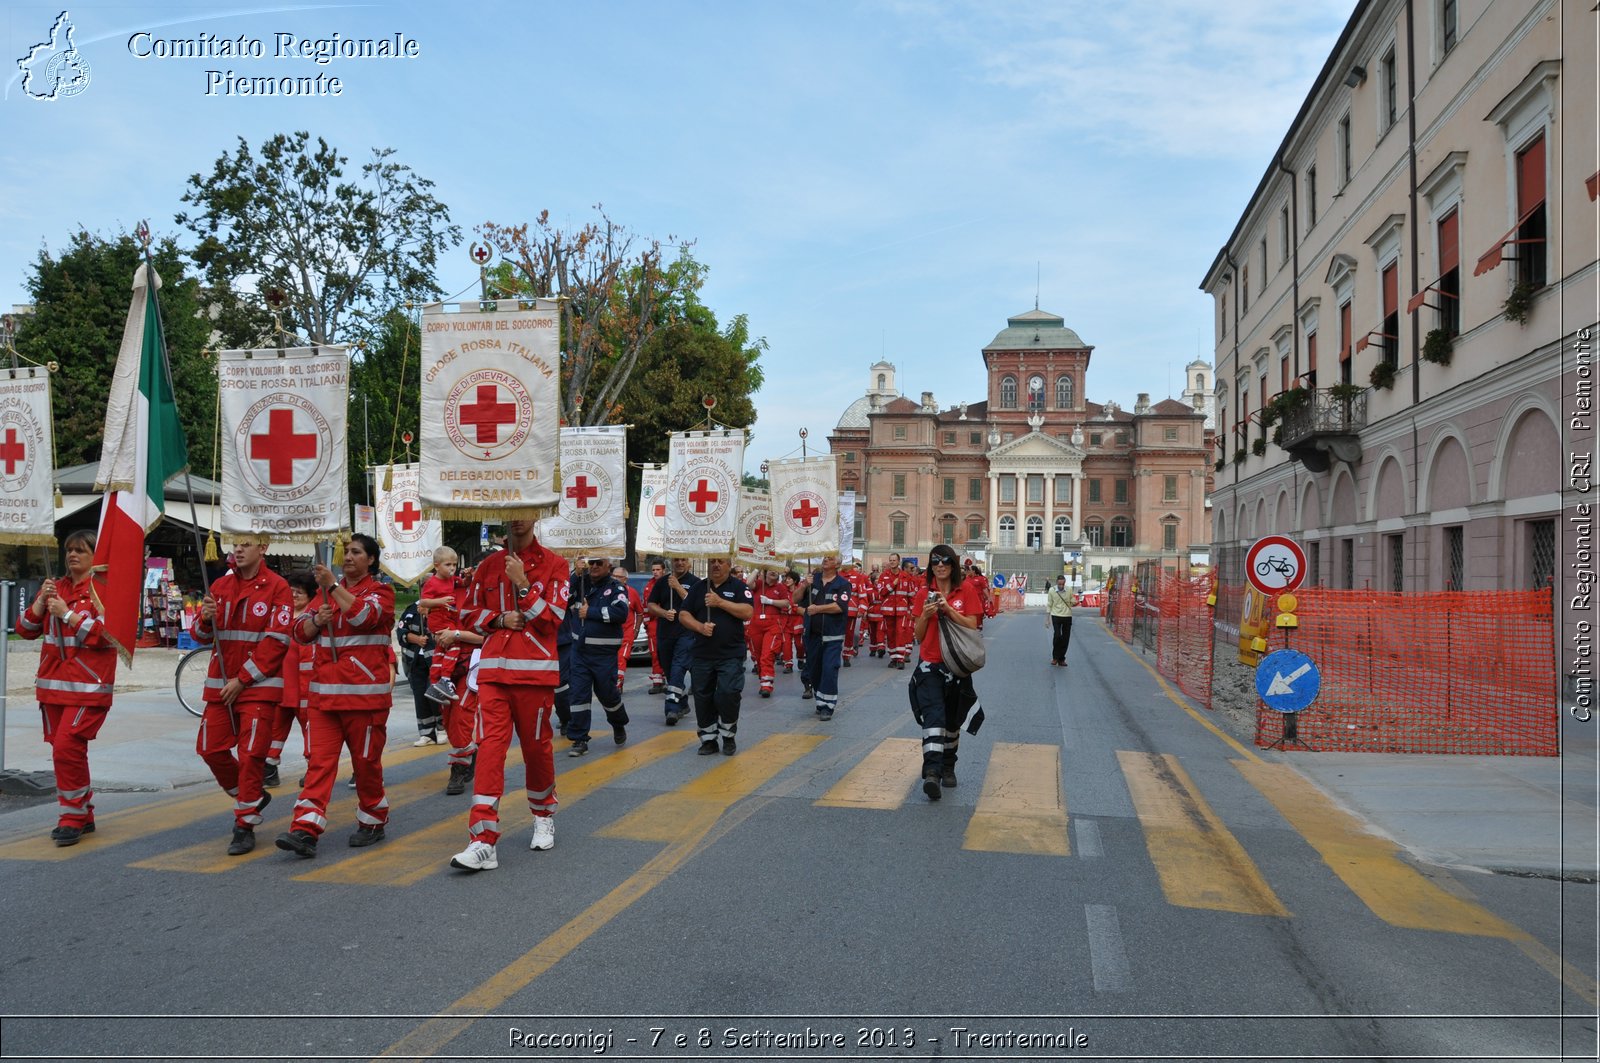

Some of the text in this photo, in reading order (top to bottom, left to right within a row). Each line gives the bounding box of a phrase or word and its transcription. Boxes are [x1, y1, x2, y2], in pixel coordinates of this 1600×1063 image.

[427, 318, 553, 333] CORPO VOLONTARI DEL SOCCORSO
[426, 339, 554, 383] CROCE ROSSA ITALIANA
[289, 365, 304, 375] DEL
[221, 374, 346, 390] CROCE ROSSA ITALIANA
[239, 394, 329, 436] CONVENZIONE DI GINEVRA
[445, 386, 466, 449] CONVENZIONE
[461, 378, 470, 389] DI
[470, 371, 508, 385] GINEVRA
[509, 379, 520, 391] 22
[517, 390, 533, 429] AGOSTO
[565, 448, 588, 457] ROSSA
[687, 456, 715, 469] ROSSA
[439, 469, 539, 482] DELEGAZIONE DI
[452, 488, 522, 502] PAESANA
[233, 503, 280, 515] COMITATO
[283, 503, 326, 515] LOCALE
[250, 517, 327, 530] RACCONIGI
[548, 528, 583, 537] COMITATO
[583, 527, 609, 536] LOCALE
[669, 529, 699, 537] COMITATO
[698, 537, 732, 546] DALMAZZ
[384, 549, 433, 561] SAVIGLIANO
